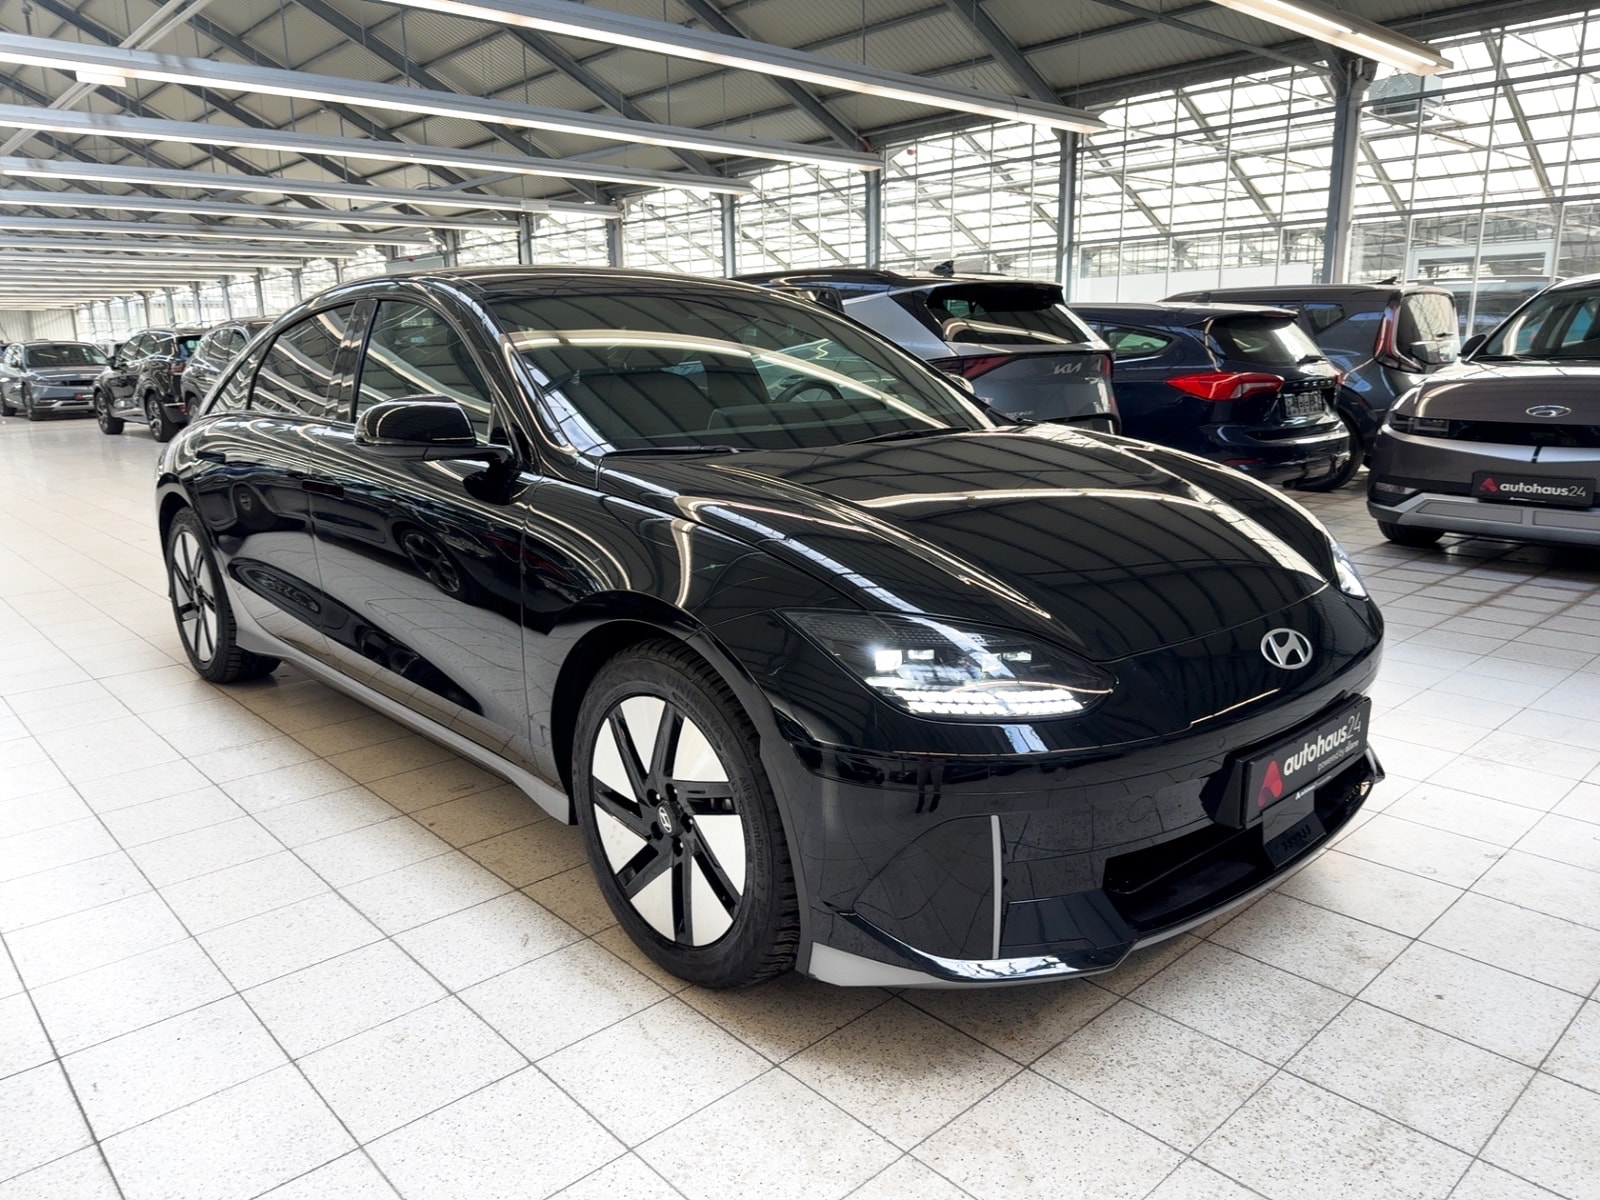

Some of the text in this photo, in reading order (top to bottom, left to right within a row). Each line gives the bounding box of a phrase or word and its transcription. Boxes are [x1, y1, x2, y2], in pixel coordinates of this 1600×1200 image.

[1053, 362, 1082, 375] KIA
[1500, 482, 1586, 497] autohaus24
[1284, 712, 1361, 776] autohaus24
